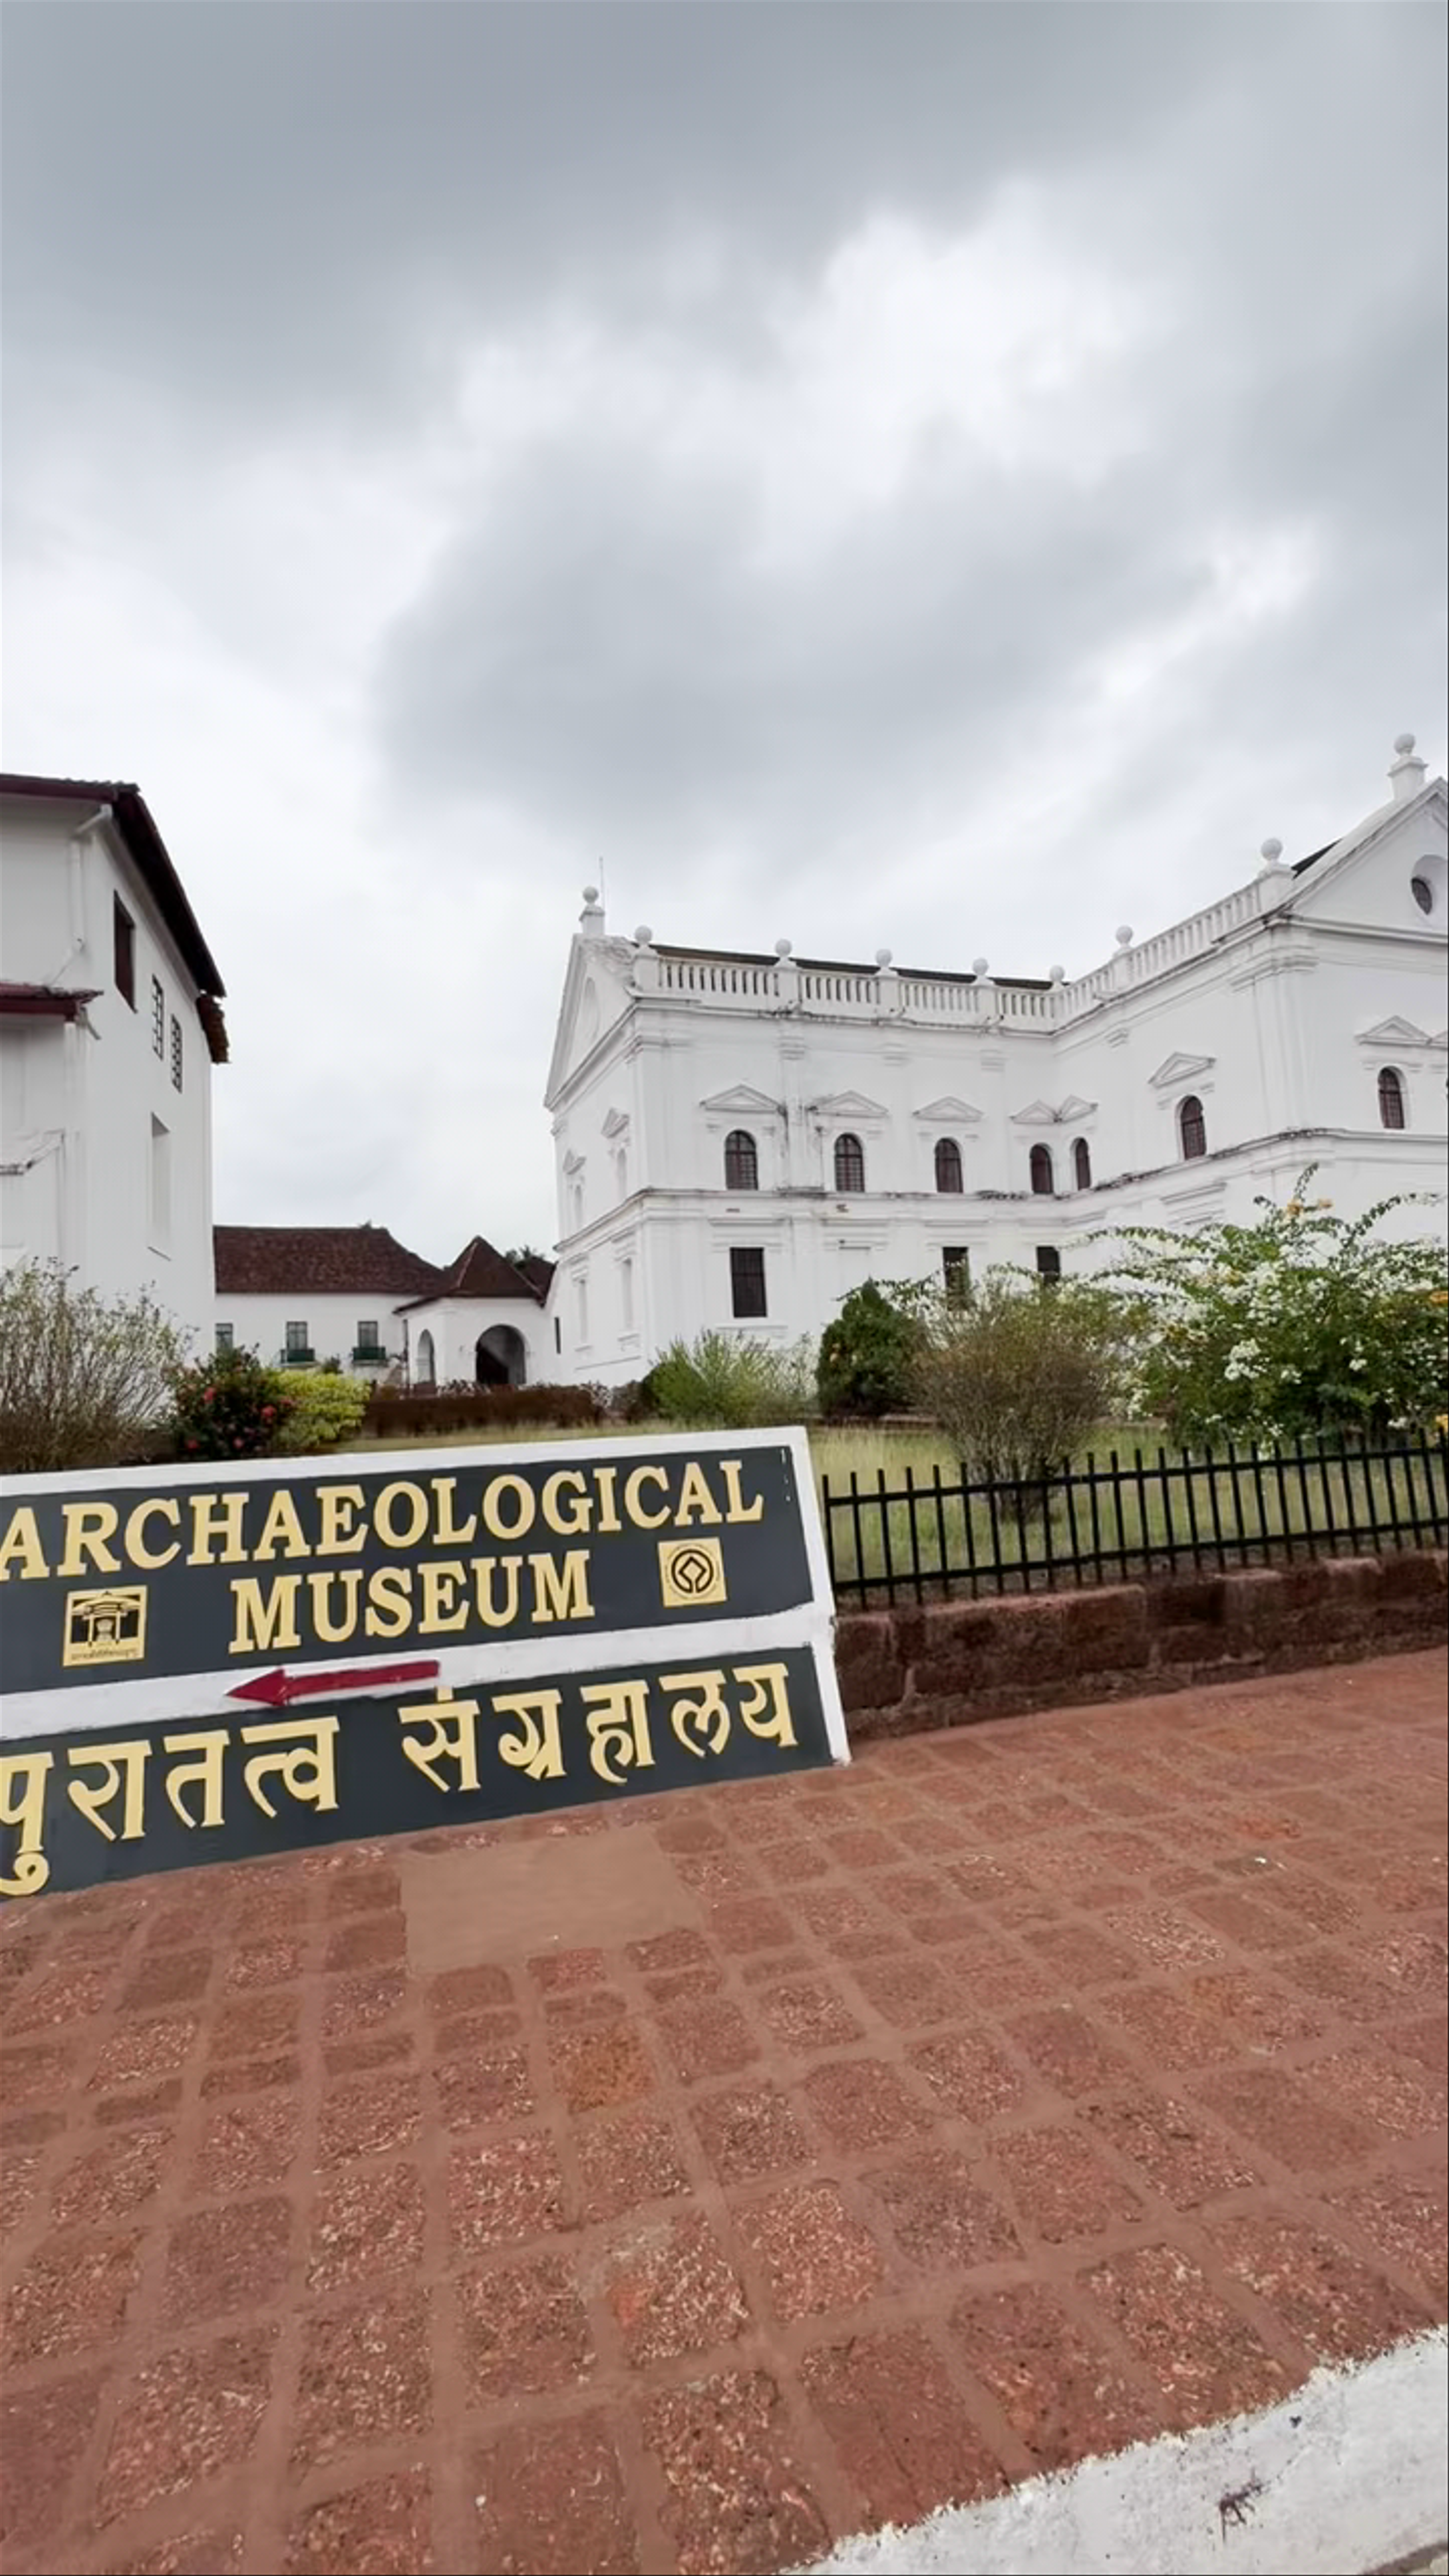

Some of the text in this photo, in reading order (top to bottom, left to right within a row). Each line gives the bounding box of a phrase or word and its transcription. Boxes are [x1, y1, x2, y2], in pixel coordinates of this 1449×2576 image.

[0, 1460, 764, 1581] ARCHAEOLOGICAL
[228, 1550, 595, 1654] MUSEUM
[0, 1662, 798, 1896] पुरातत्व संग्रहालय
